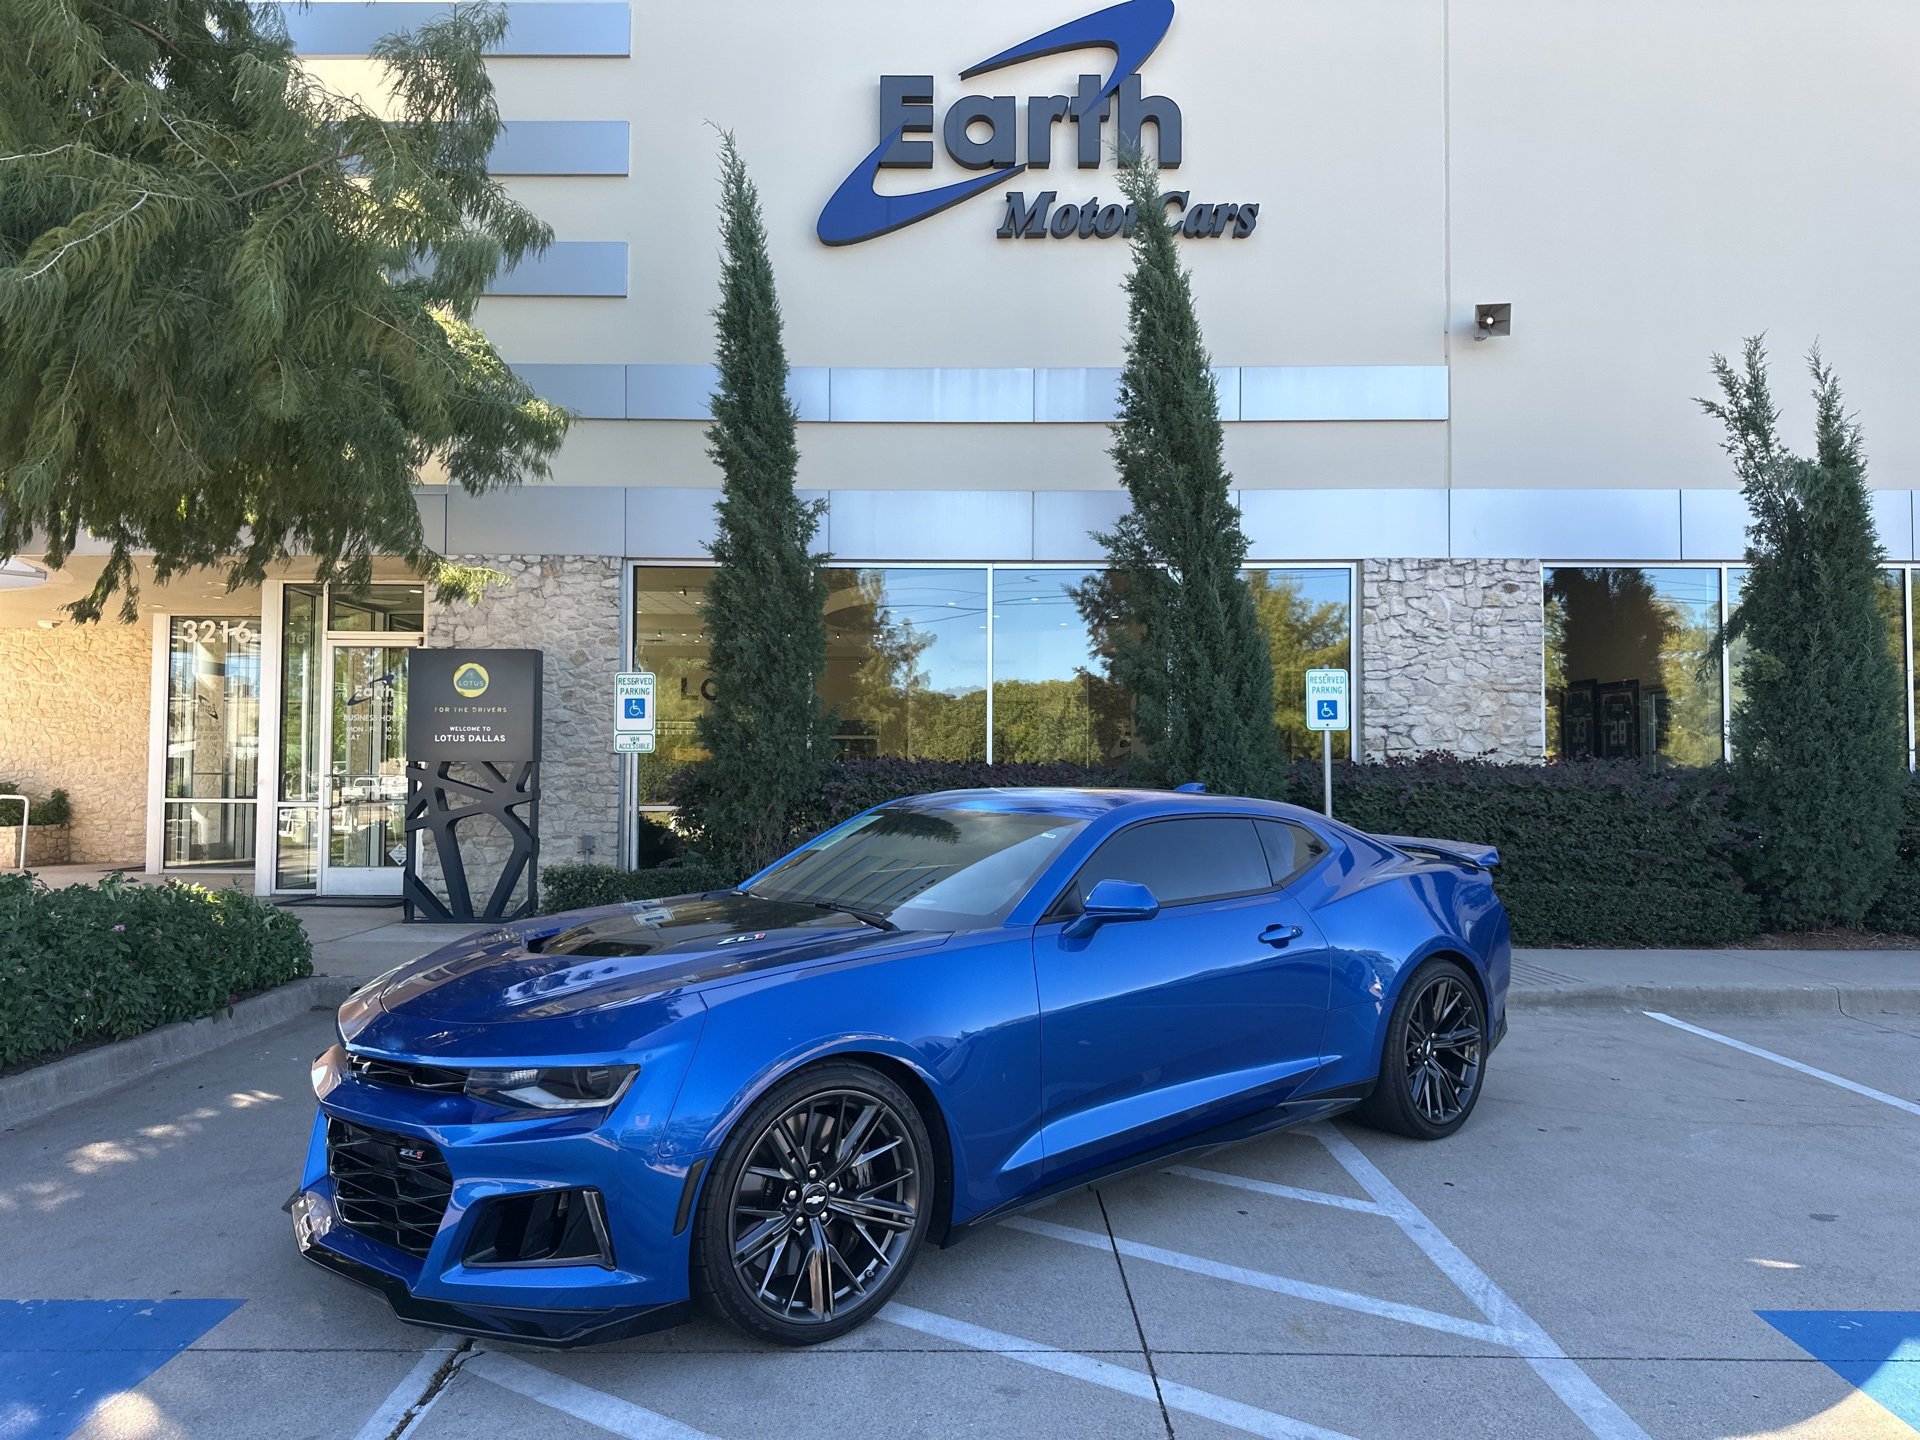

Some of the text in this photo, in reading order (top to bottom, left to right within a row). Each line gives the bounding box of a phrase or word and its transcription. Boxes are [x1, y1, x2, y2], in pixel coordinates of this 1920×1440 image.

[879, 74, 1183, 170] Earth
[1153, 190, 1260, 239] Cars
[182, 620, 252, 643] 3216
[618, 677, 652, 685] RESERVED
[1309, 676, 1344, 684] RESERVED
[620, 687, 650, 695] PARKING
[1311, 686, 1343, 694] PARKING
[434, 734, 506, 742] LOTUS DALLAS
